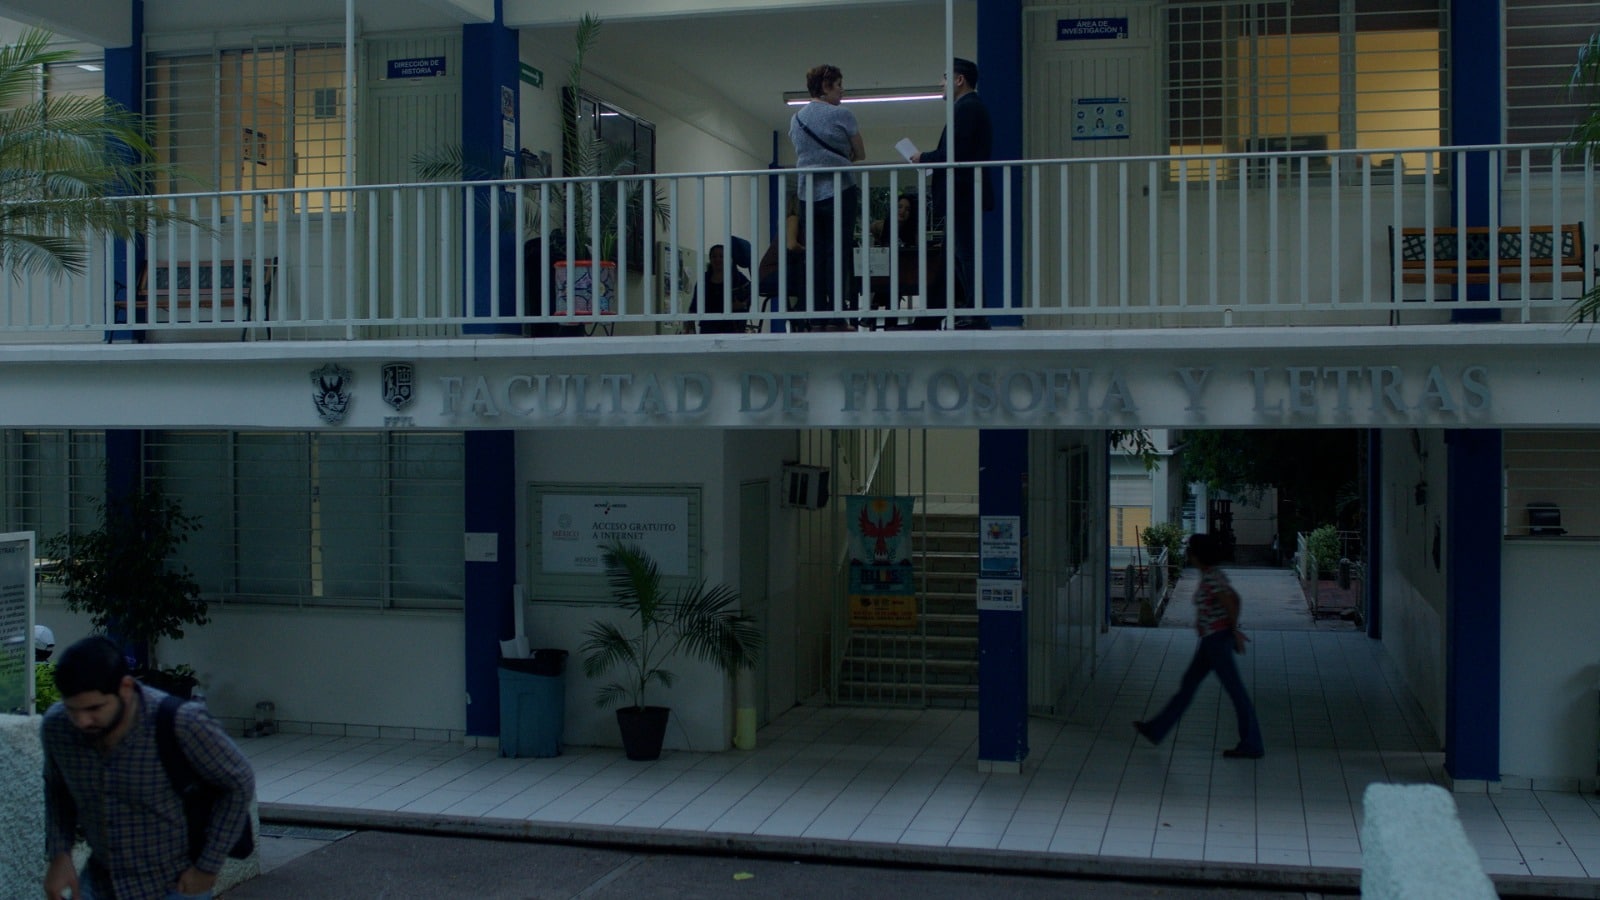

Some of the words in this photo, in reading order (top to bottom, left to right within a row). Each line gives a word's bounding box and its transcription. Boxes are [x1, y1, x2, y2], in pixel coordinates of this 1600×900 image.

[401, 67, 432, 75] HISTORIA
[439, 371, 714, 417] FACULTAD
[738, 370, 809, 414] DE
[1176, 366, 1214, 412] Y
[1252, 364, 1493, 412] LETRAS
[592, 522, 626, 531] ACCESO
[629, 522, 676, 532] GRATUITO
[592, 532, 599, 540] A
[601, 532, 644, 540] INTERNET
